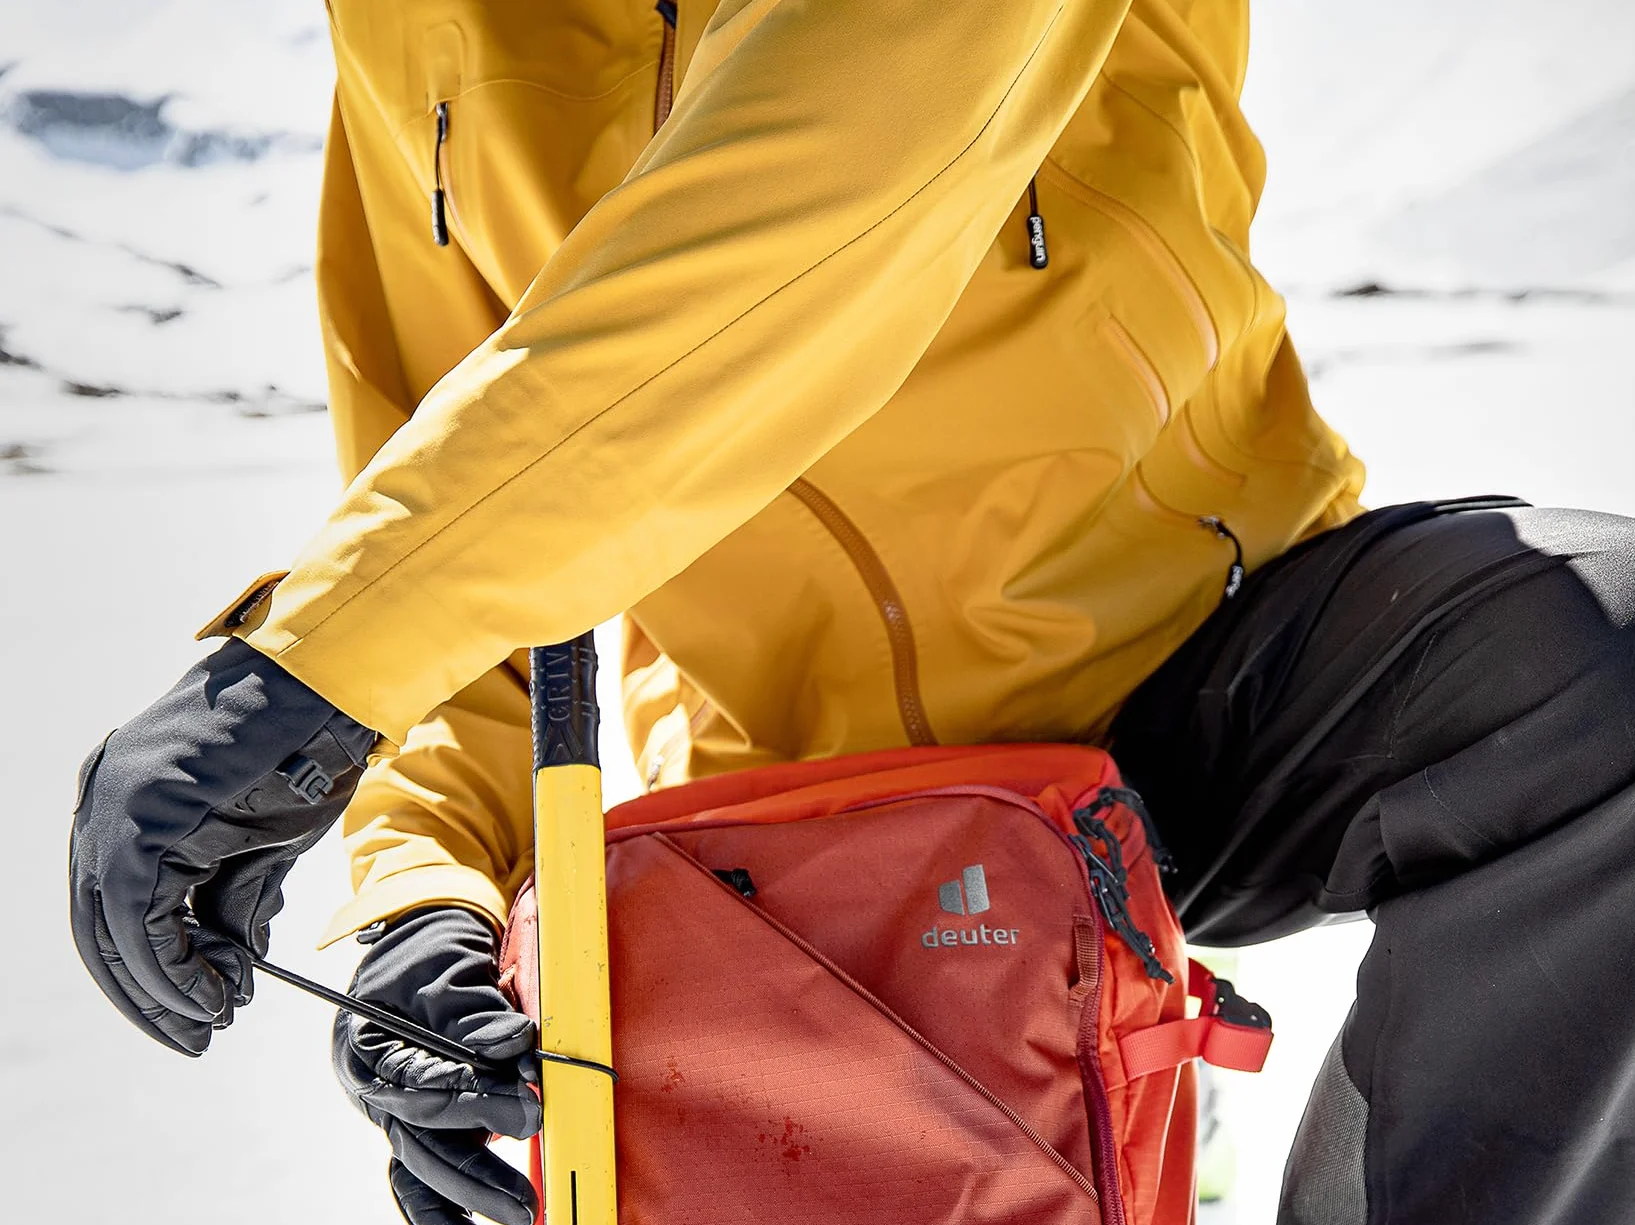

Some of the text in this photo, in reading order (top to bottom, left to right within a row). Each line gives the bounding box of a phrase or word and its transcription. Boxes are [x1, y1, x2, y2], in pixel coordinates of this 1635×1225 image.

[1029, 216, 1046, 263] penguin
[545, 650, 571, 721] GRIV
[921, 924, 1020, 949] deuter
